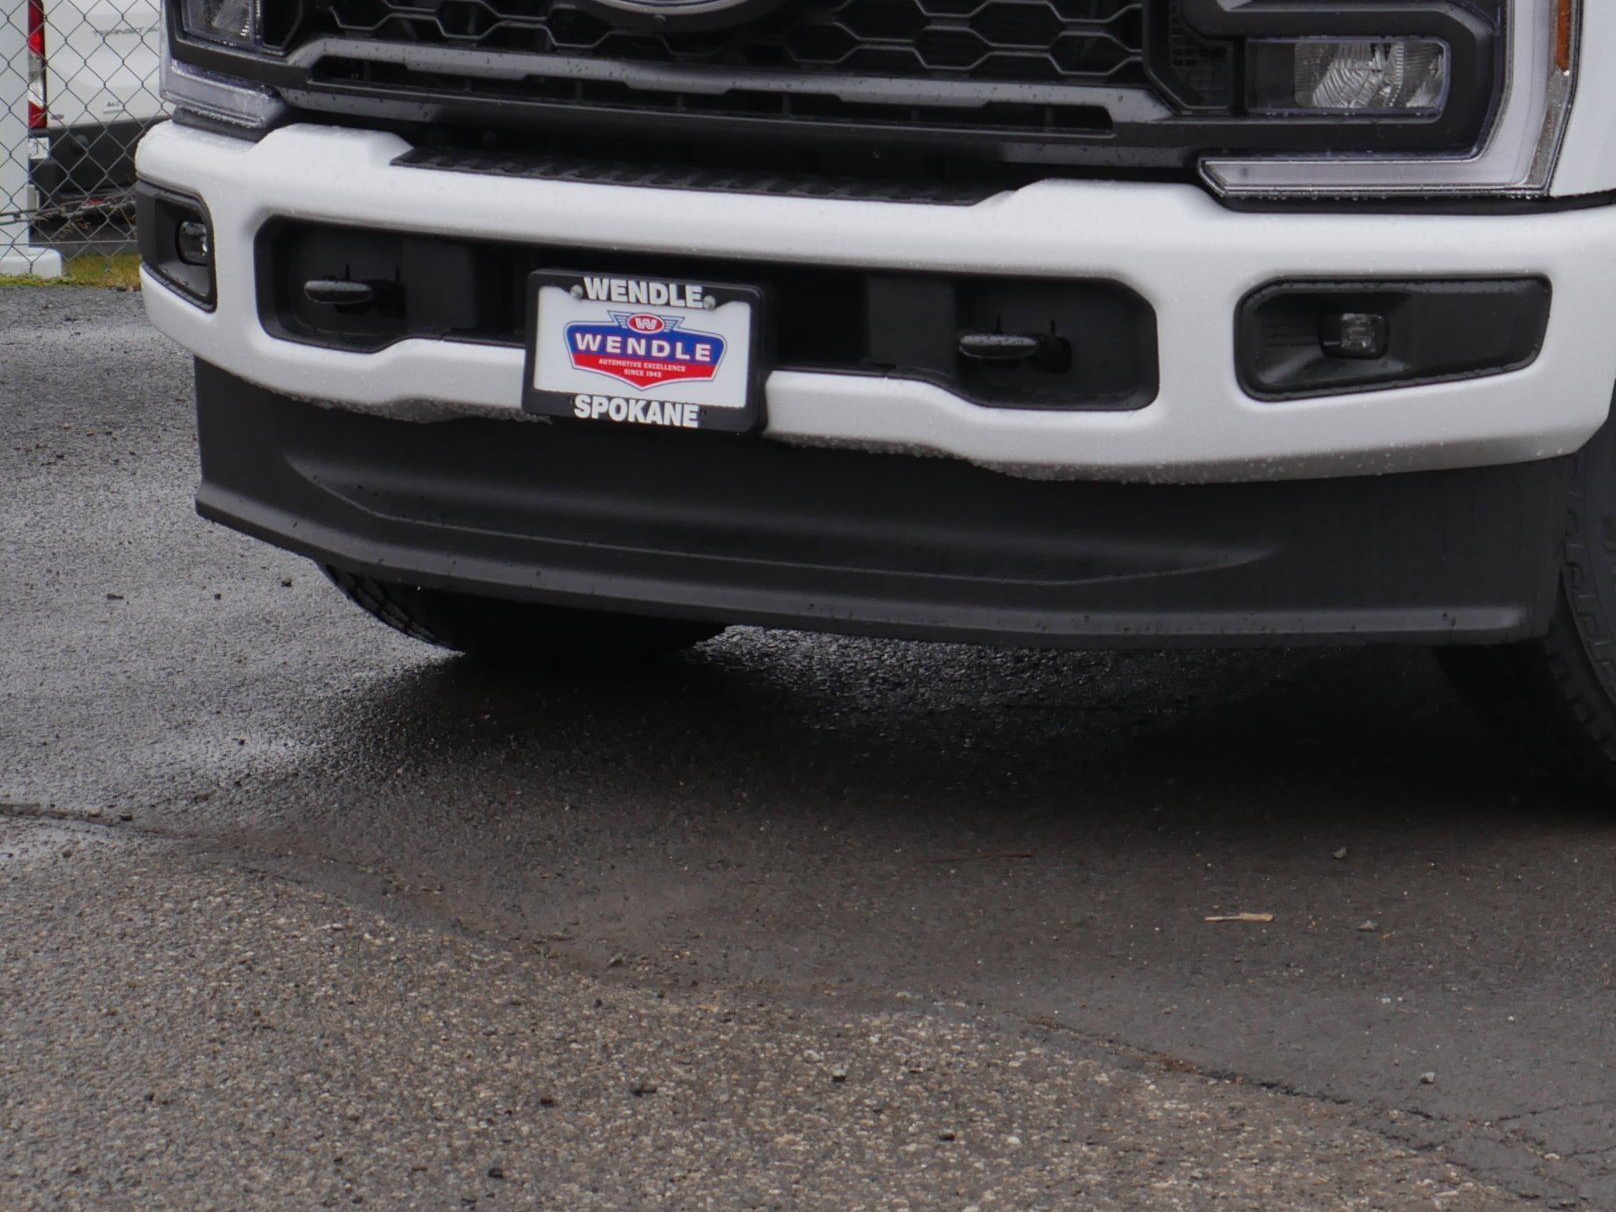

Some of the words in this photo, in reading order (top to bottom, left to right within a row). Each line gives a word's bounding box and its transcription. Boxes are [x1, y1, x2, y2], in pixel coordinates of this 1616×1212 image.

[584, 276, 704, 308] WENDLE
[575, 333, 711, 361] WENDLE
[598, 358, 642, 368] AUTOMOTIVE
[643, 362, 686, 372] EXCELLENCE
[624, 368, 645, 377] SINCE
[574, 394, 700, 428] SPOKANE
